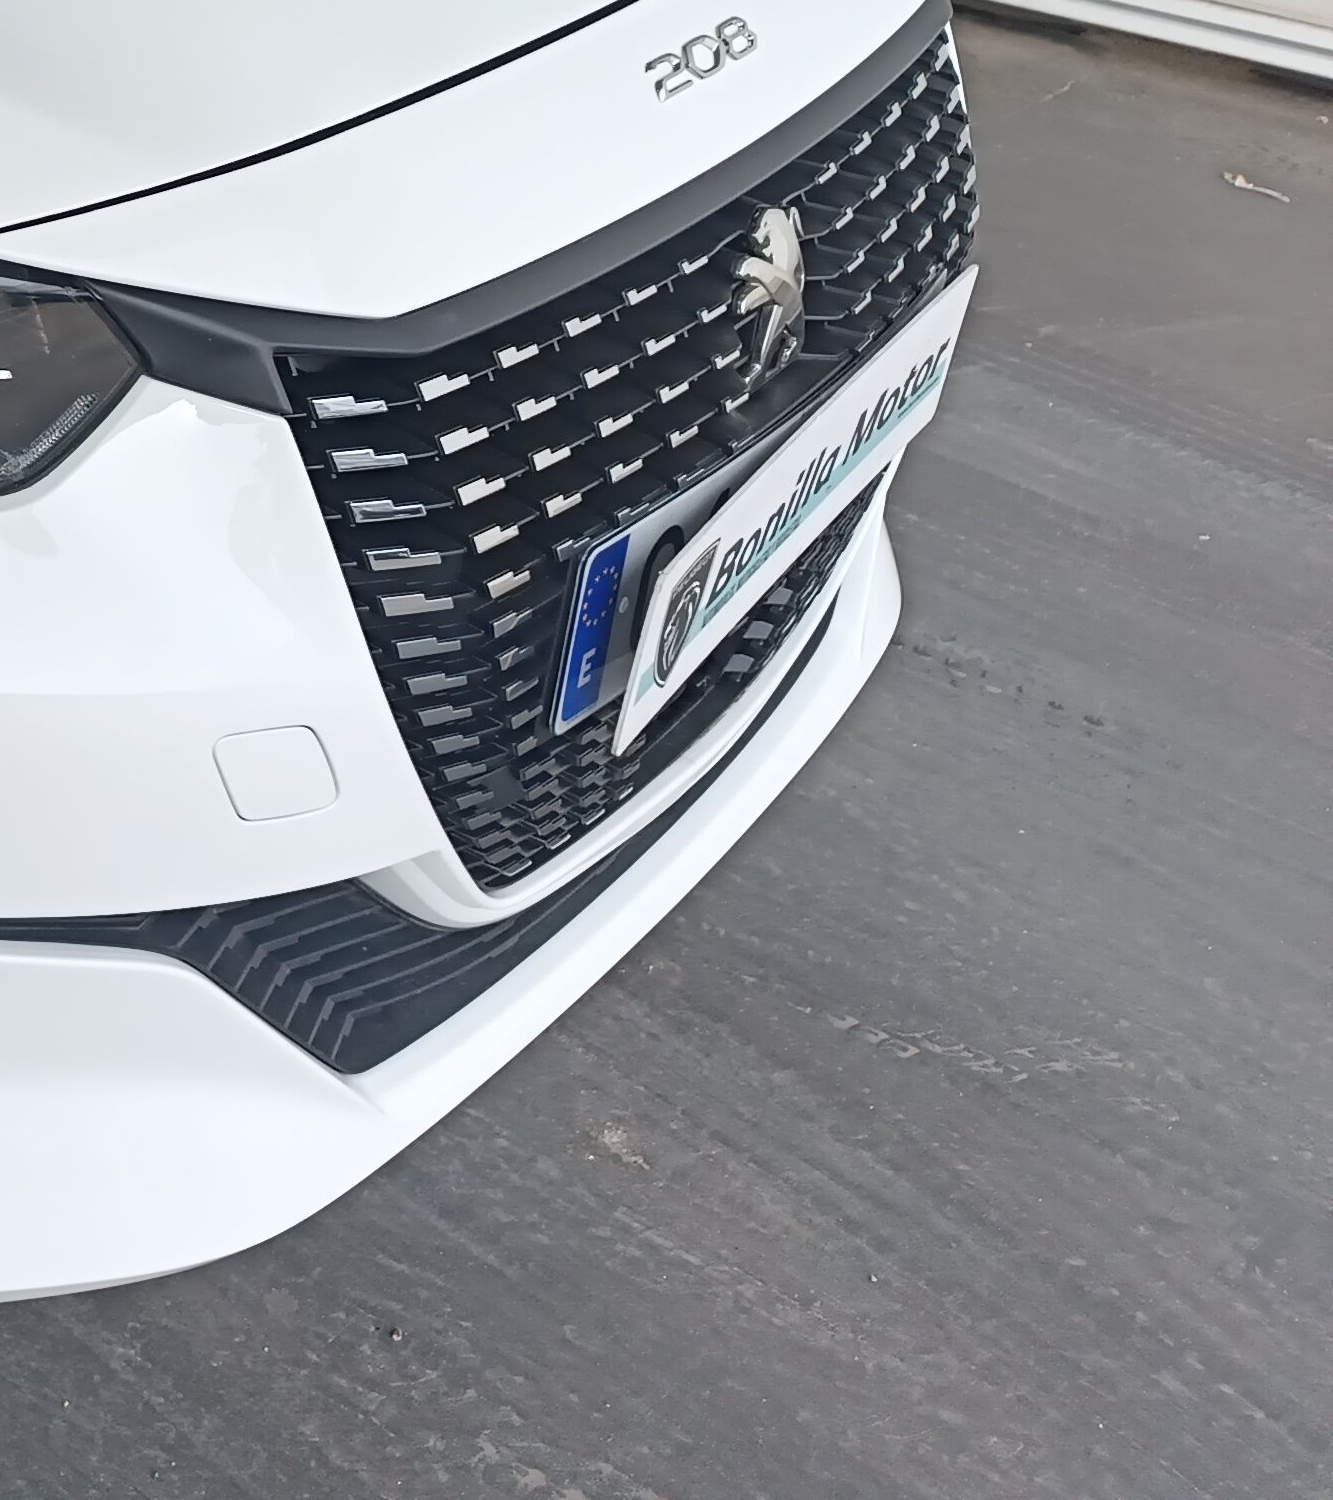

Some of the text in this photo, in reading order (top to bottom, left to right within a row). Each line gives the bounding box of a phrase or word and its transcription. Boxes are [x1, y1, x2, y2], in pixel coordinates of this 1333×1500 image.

[645, 16, 757, 102] 208
[705, 337, 951, 609] Bonilla Motor
[576, 647, 597, 689] E
